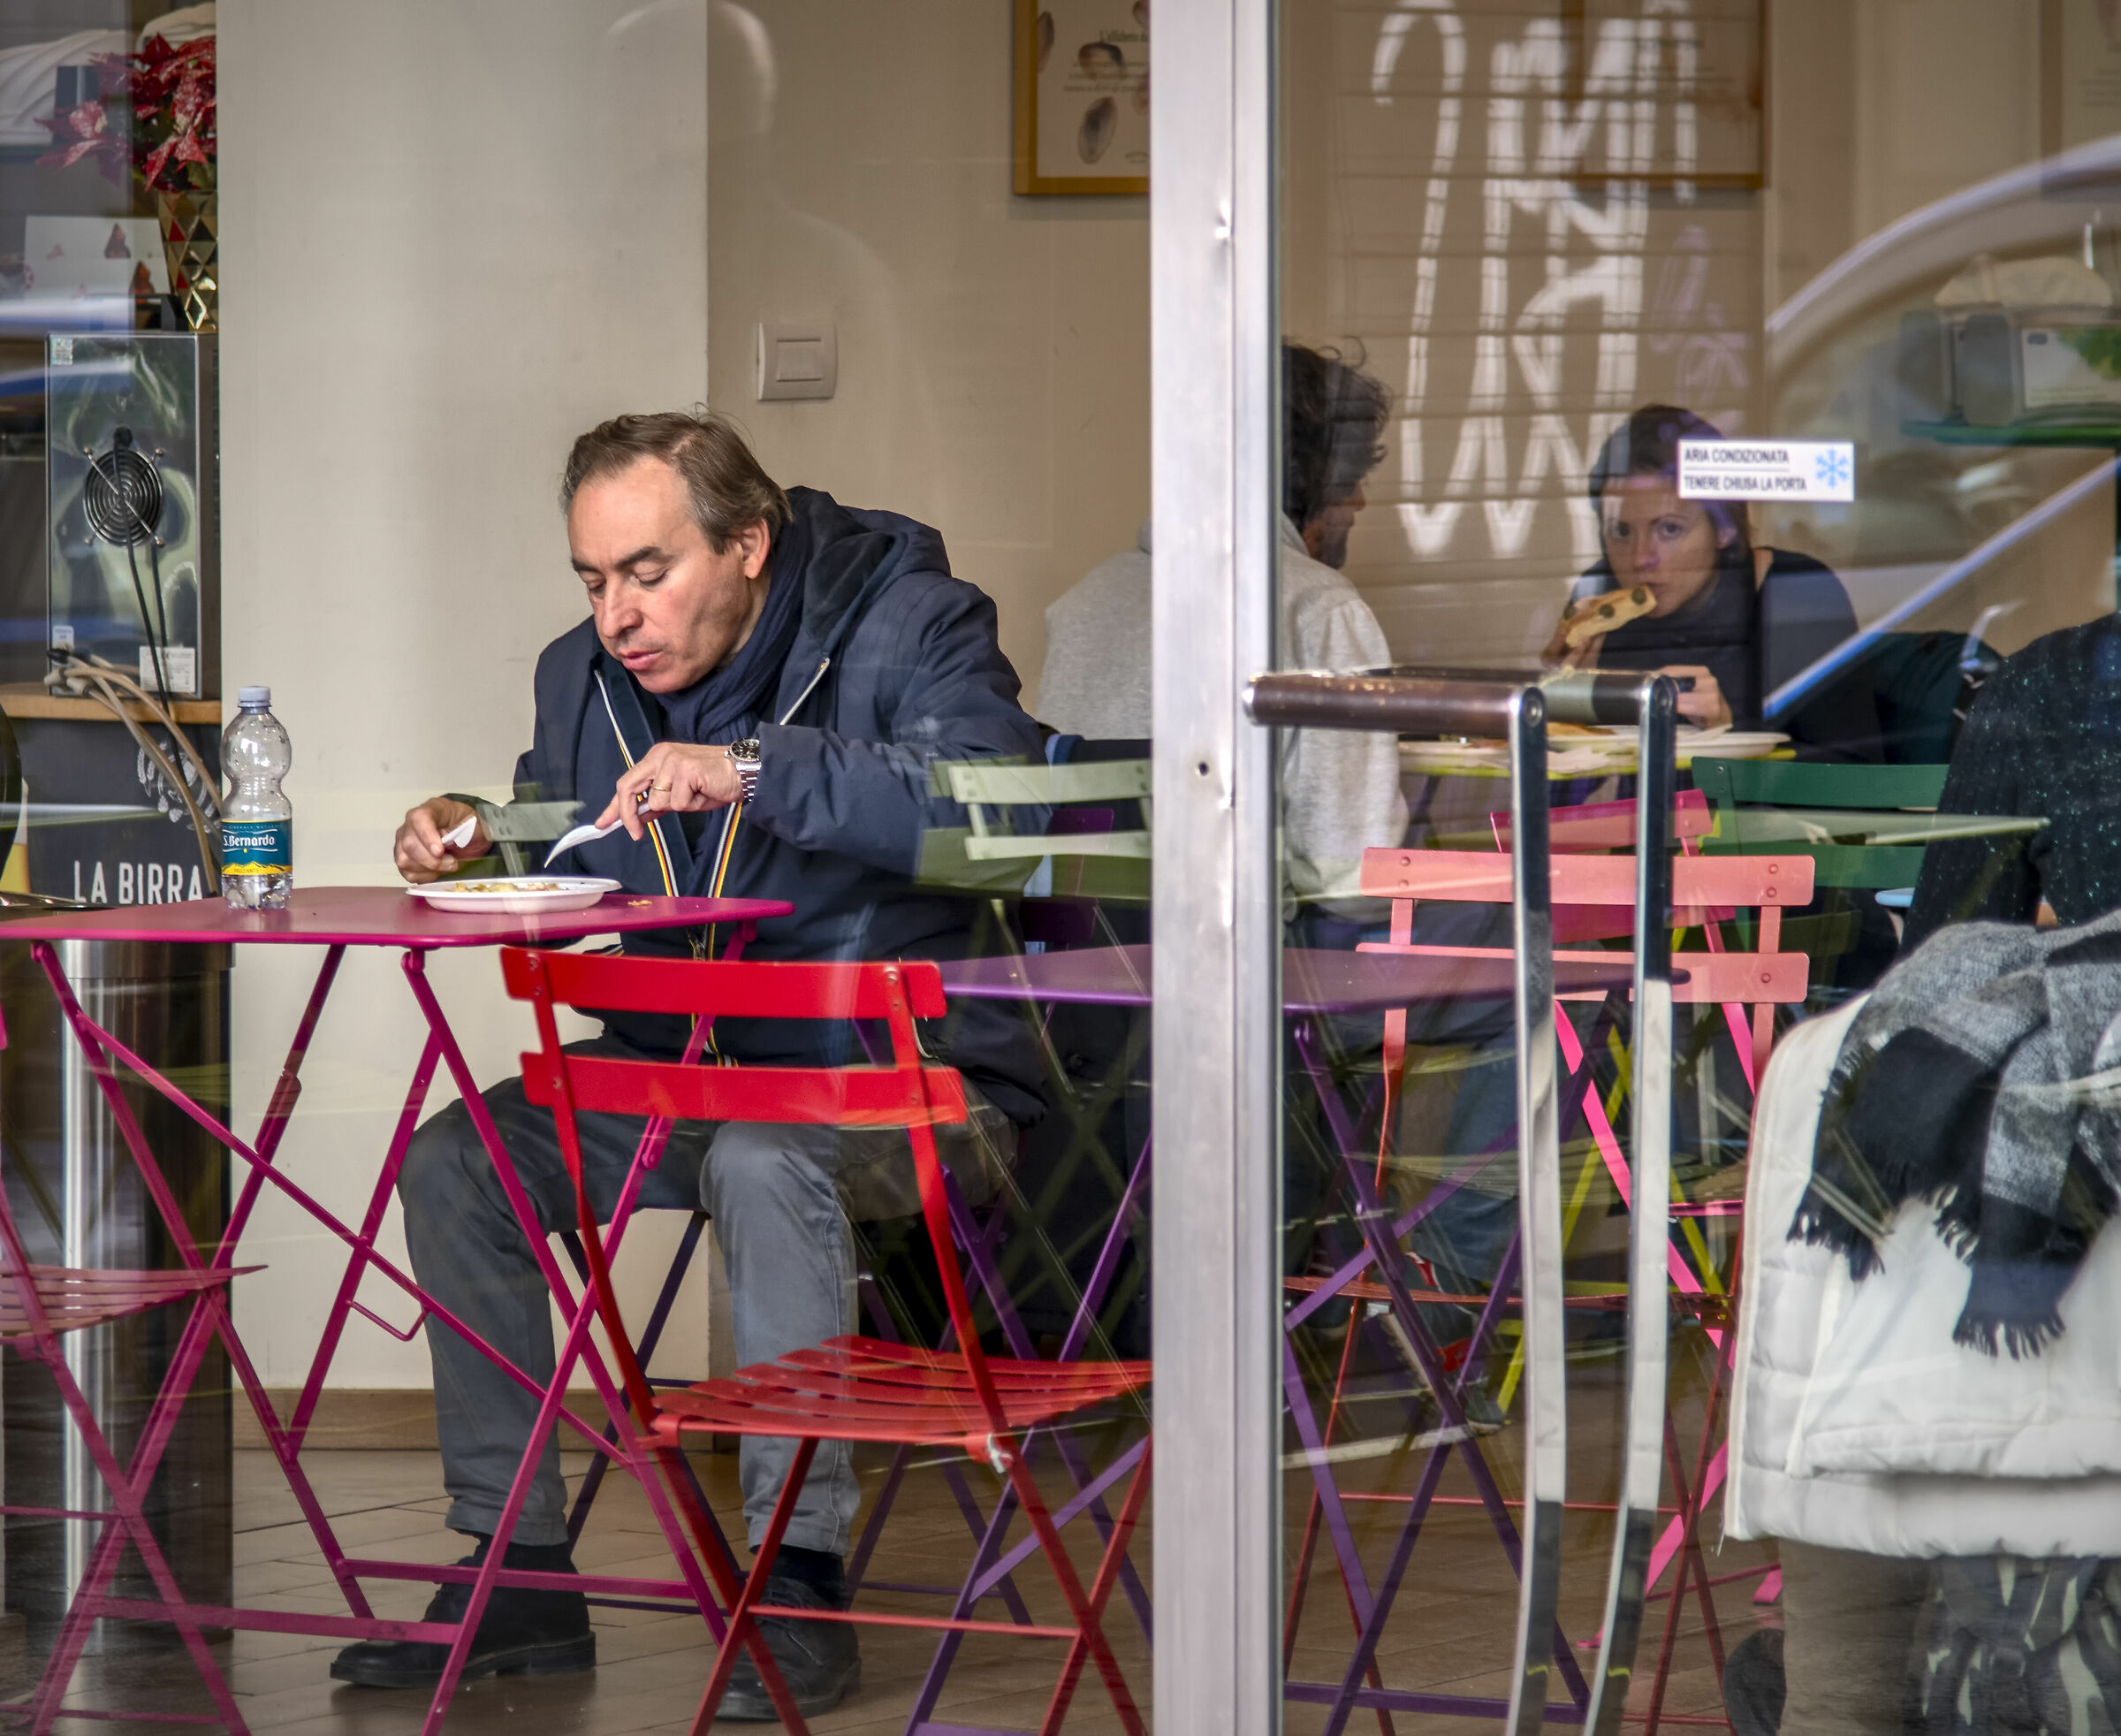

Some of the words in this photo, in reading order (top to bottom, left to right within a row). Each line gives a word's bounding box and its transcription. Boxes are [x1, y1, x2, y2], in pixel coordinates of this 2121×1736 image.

[1684, 448, 1708, 462] ARIA
[1712, 449, 1789, 463] CONDIZIONATA
[1684, 476, 1720, 491] TENERE
[1723, 476, 1757, 491] CHIUSA
[1760, 477, 1772, 491] LA
[1775, 477, 1806, 492] PORTA
[223, 834, 276, 847] S.Bernardo
[74, 860, 108, 904] LA
[118, 863, 203, 905] BIRRA
